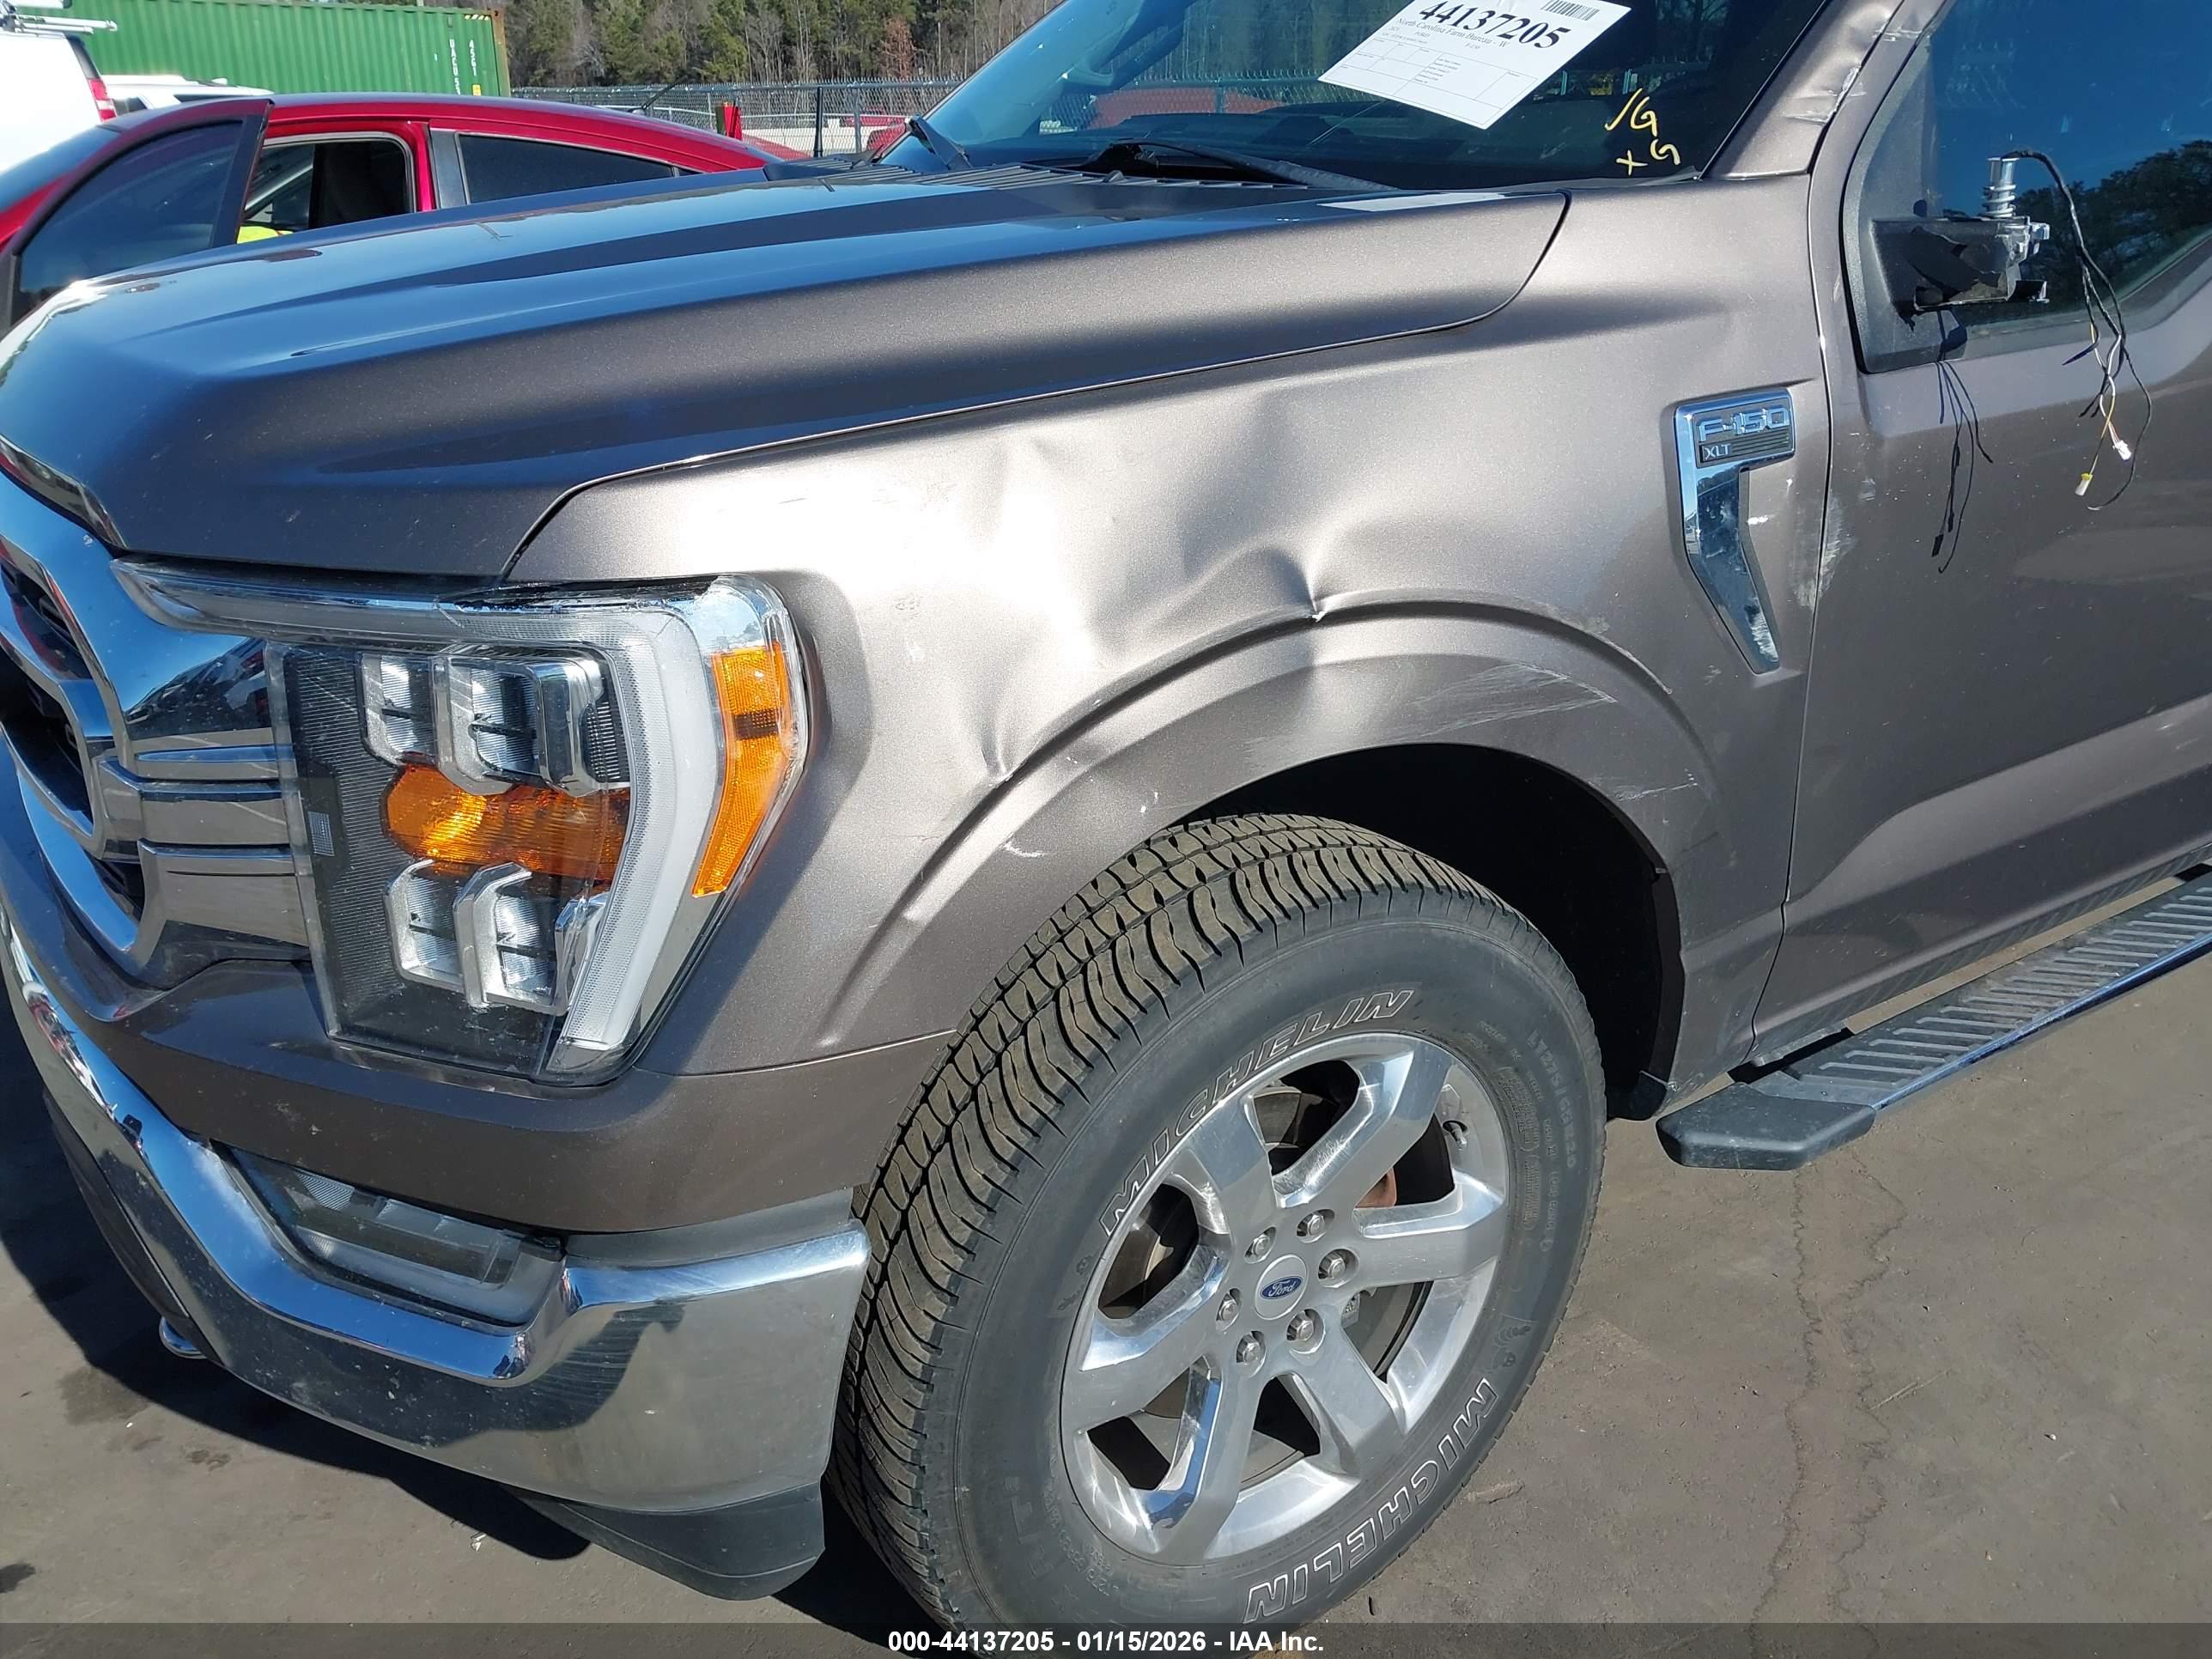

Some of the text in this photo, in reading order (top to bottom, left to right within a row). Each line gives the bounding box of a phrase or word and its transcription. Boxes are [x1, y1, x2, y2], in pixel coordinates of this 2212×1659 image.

[1396, 18, 1417, 27] North
[1416, 21, 1446, 33] Carolina
[1445, 27, 1466, 38] Farm
[1464, 33, 1492, 45] Bureau
[1419, 0, 1572, 49] 44137205
[1698, 404, 1790, 442] F-150
[1704, 443, 1731, 461] XLT
[1098, 989, 1416, 1237] MICHELIN
[1267, 1279, 1297, 1297] Ford
[1243, 1376, 1498, 1625] MICHELIN
